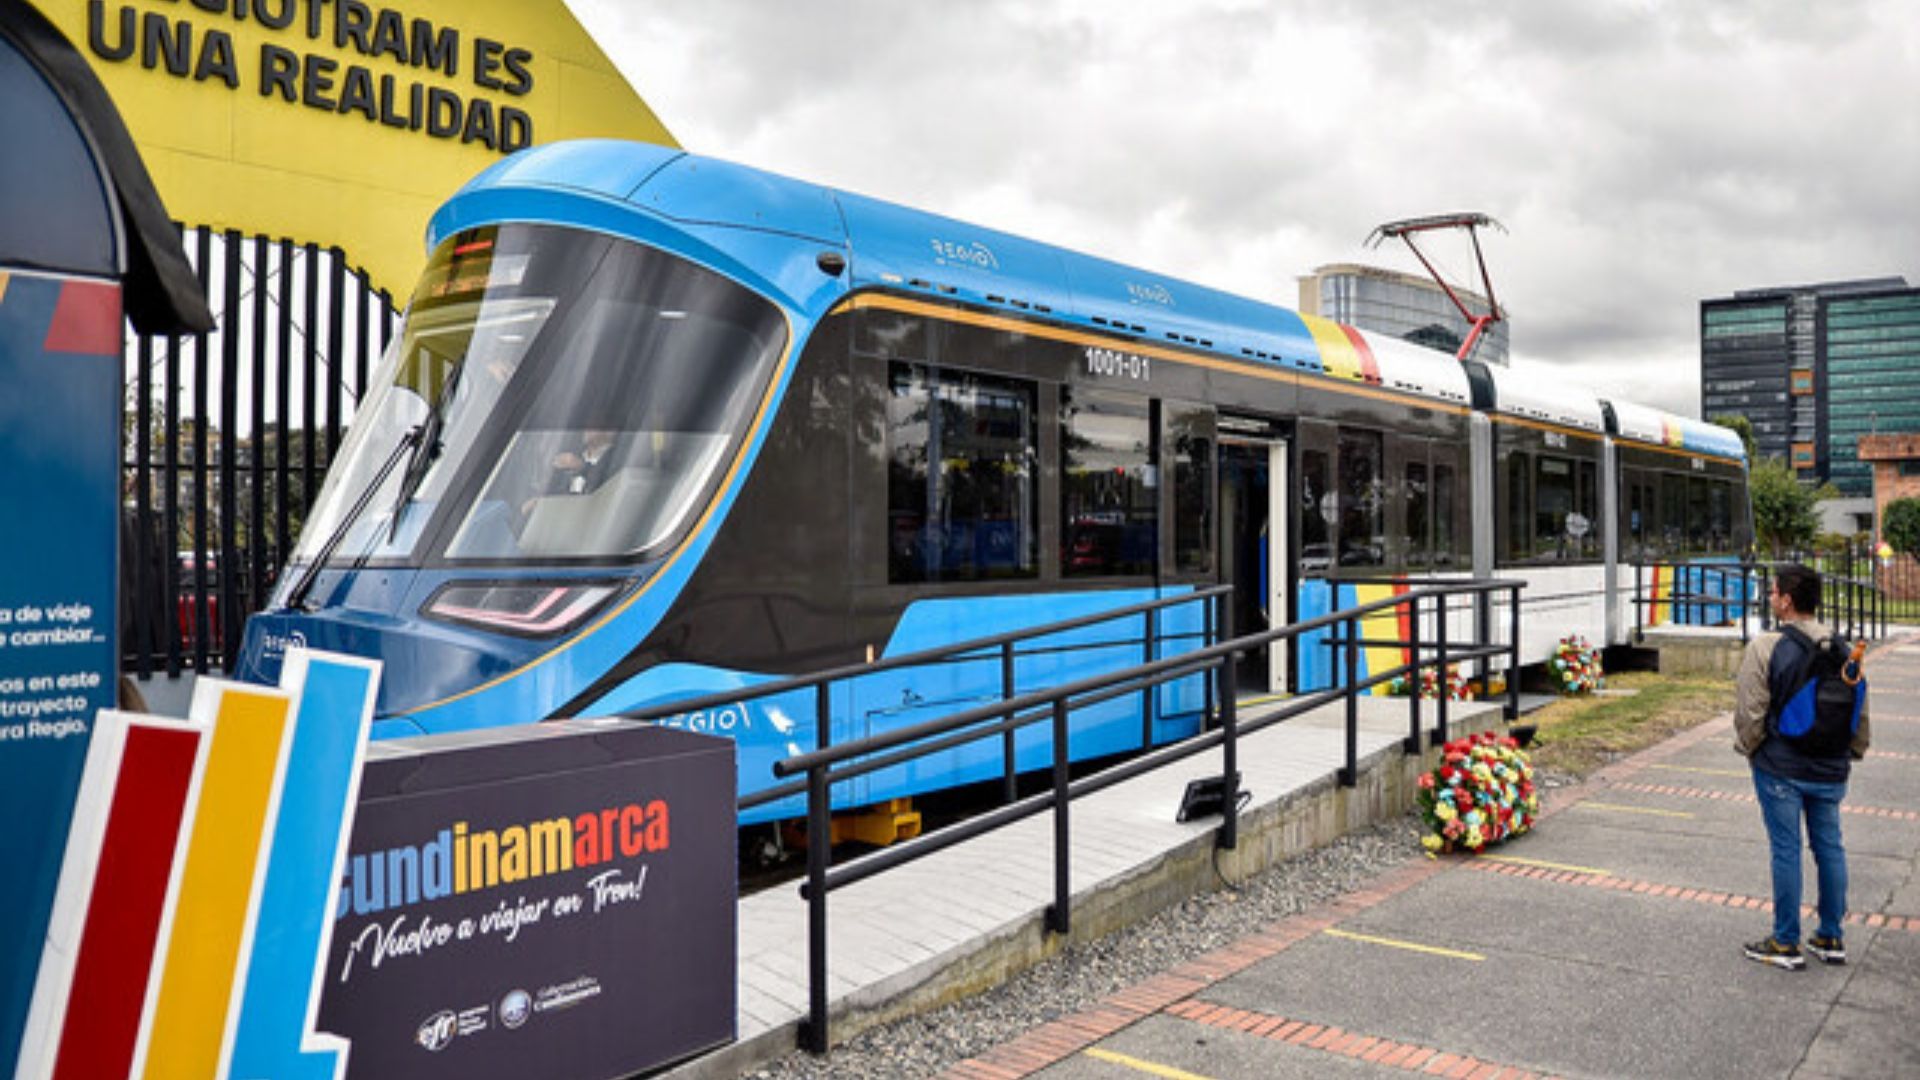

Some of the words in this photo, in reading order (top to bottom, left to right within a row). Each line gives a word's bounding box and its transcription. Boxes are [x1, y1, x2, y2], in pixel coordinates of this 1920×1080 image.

[166, 0, 459, 76] OTRAM
[473, 38, 534, 96] ES
[88, 0, 240, 90] UNA
[260, 43, 533, 154] REALIDAD
[1085, 347, 1151, 382] 1001-01
[15, 604, 42, 623] de
[46, 603, 92, 624] viaje
[29, 677, 54, 691] en
[57, 672, 100, 689] este
[1, 696, 87, 717] trayecto
[457, 916, 477, 940] a
[480, 896, 549, 944] viajar
[553, 893, 582, 917] en
[586, 865, 648, 913] Tren!
